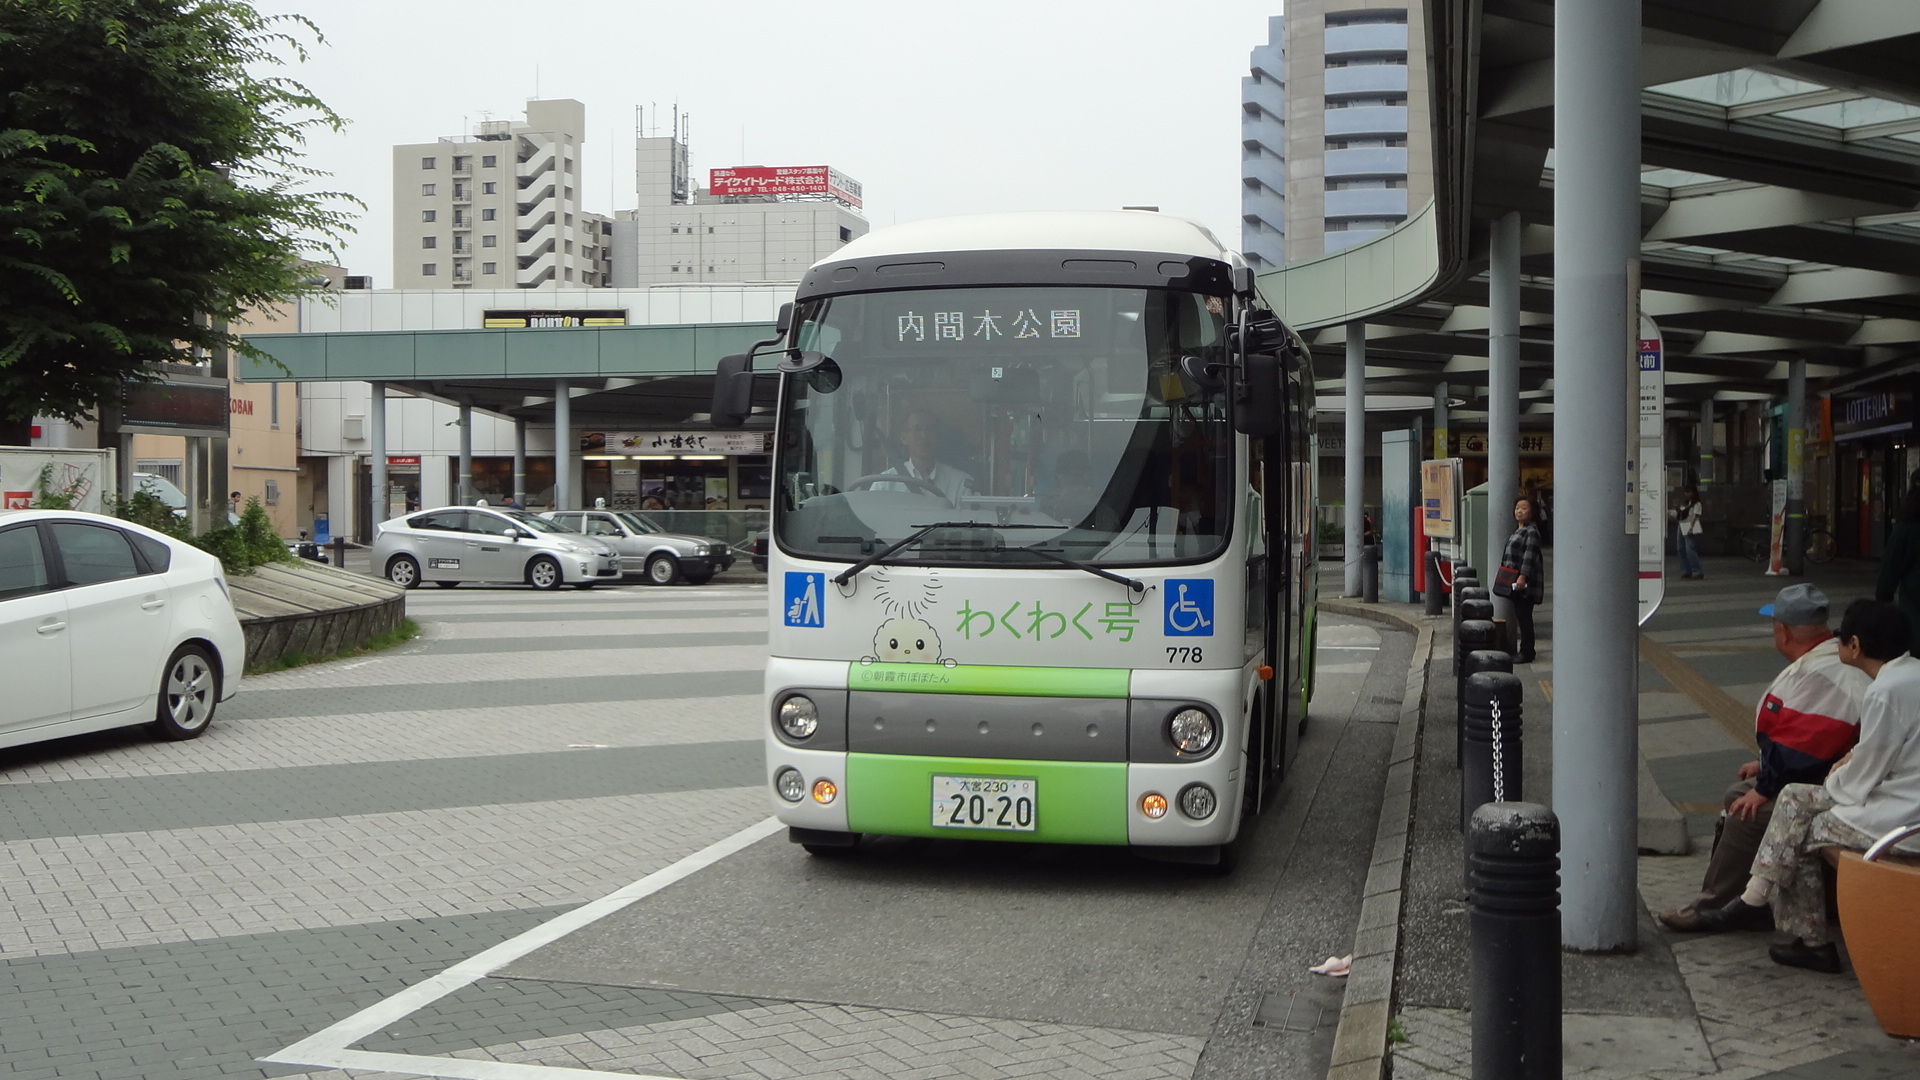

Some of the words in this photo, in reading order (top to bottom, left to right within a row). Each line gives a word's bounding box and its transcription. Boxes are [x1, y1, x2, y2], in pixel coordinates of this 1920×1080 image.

[714, 175, 826, 188] テイケイトレード株式会社
[898, 308, 1081, 342] 内間木公園
[1846, 391, 1888, 425] LOTTERIA
[956, 599, 1140, 643] わくわく号
[1165, 647, 1203, 665] 778
[950, 794, 1032, 827] 20-20
